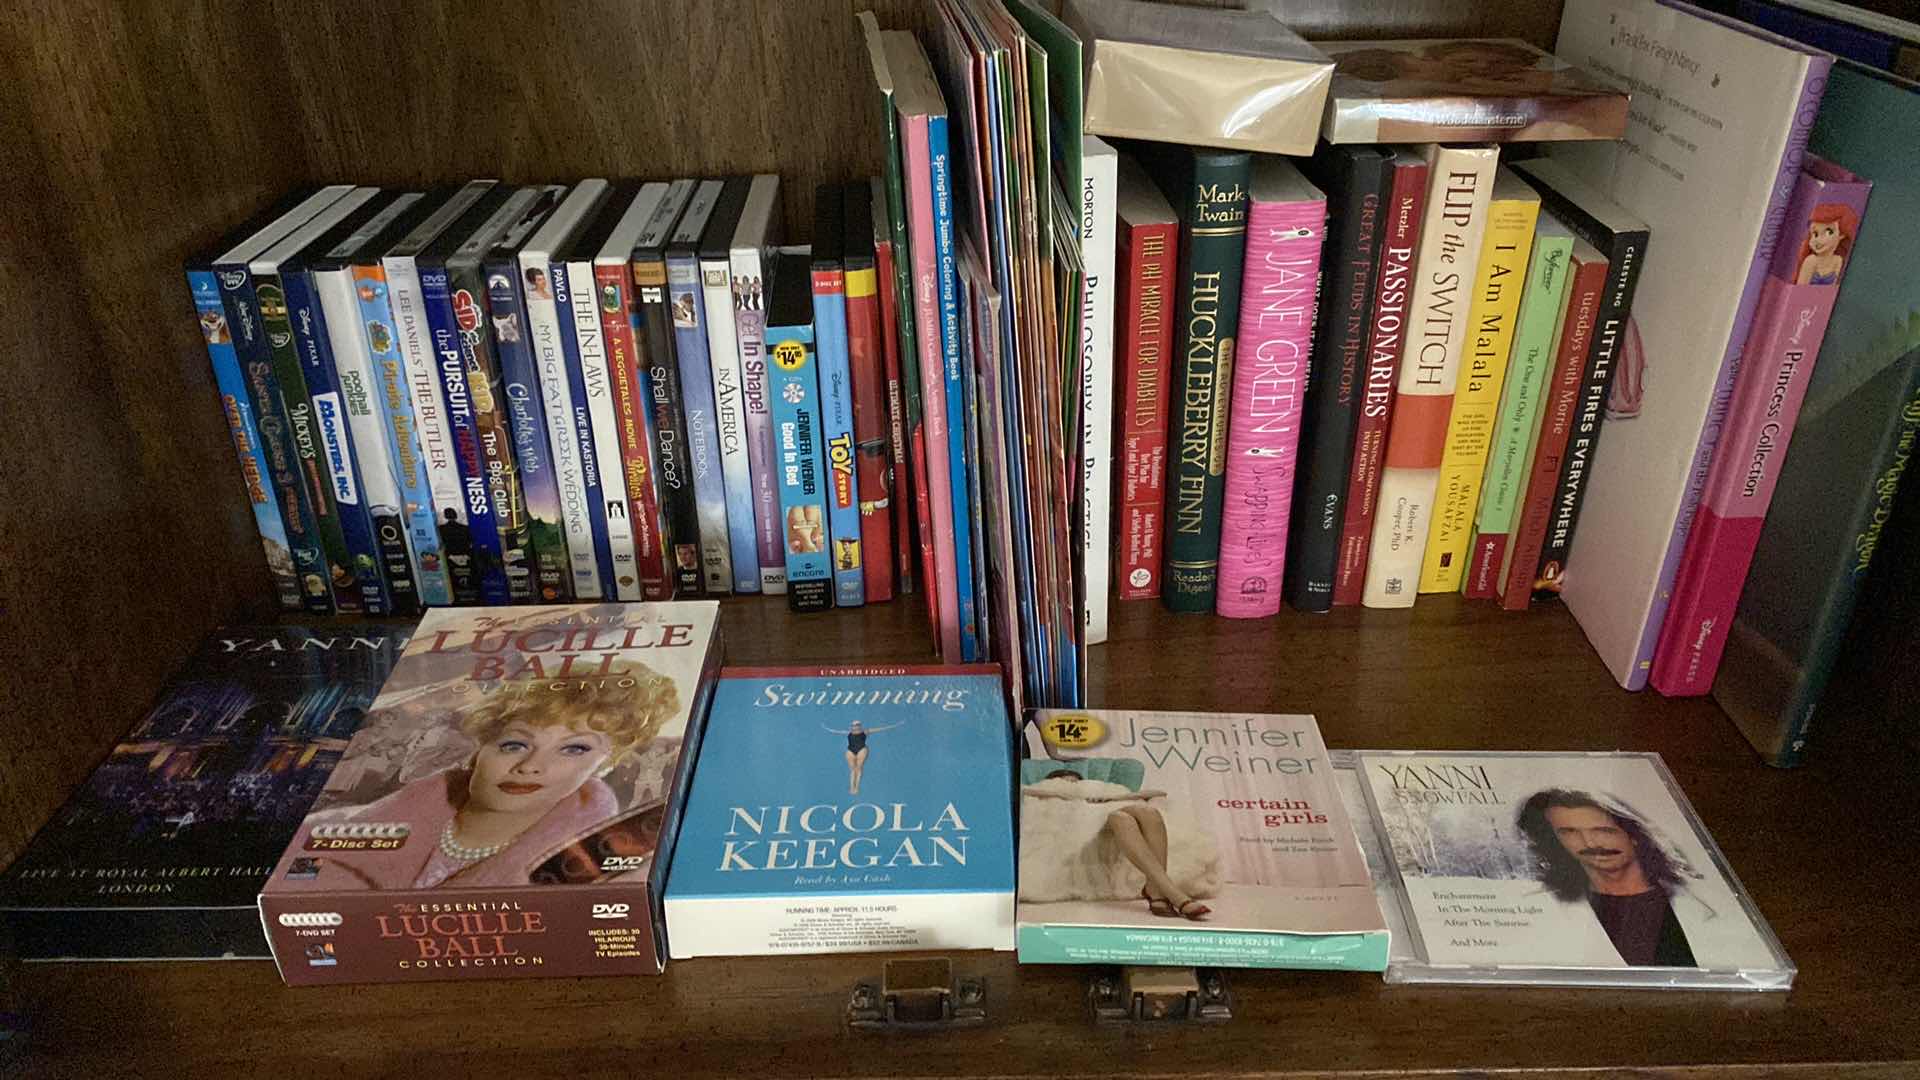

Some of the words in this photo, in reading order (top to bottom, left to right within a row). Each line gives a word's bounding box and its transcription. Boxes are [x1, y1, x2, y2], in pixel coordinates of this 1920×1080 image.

[935, 154, 946, 217] Springtime
[1198, 183, 1246, 203] Mark
[1442, 171, 1479, 228] FLIP
[1083, 177, 1094, 240] MORTON
[1197, 203, 1245, 223] Twain
[1358, 193, 1380, 253] GREAT
[1398, 196, 1414, 240] Metzler
[939, 219, 950, 254] Jumbo
[1142, 233, 1165, 259] THE
[1441, 233, 1466, 265] the
[551, 267, 568, 303] PAVLO
[943, 256, 954, 300] Coloring
[1486, 263, 1512, 303] Am
[1618, 246, 1635, 289] CELESTE
[398, 289, 412, 310] LEE
[1259, 252, 1313, 329] JANE
[1351, 260, 1371, 312] FEUDS
[1613, 292, 1625, 307] NG
[453, 288, 480, 333] SID
[573, 288, 595, 325] THE
[945, 302, 956, 312] &
[1139, 285, 1162, 337] MIRACLE
[1348, 312, 1362, 332] IN
[1571, 290, 1596, 353] tuesdays
[435, 329, 450, 351] the
[538, 324, 552, 342] MY
[946, 312, 958, 356] Activity
[1364, 246, 1412, 418] PASSIONARIES
[1416, 271, 1460, 385] SWITCH
[541, 346, 557, 379] BIG
[577, 327, 605, 398] IN-LAWS
[743, 341, 763, 357] In
[1137, 343, 1160, 366] FOR
[1469, 313, 1503, 393] Malala
[1593, 319, 1620, 380] LITTLE
[440, 350, 471, 418] PURSUIT
[650, 366, 670, 403] Shall
[718, 368, 731, 381] IN
[949, 356, 959, 381] Book
[1181, 271, 1220, 470] HUCKLEBERRY
[1250, 339, 1300, 433] GREEN
[1337, 334, 1360, 406] HISTORY
[1562, 357, 1581, 386] with
[1767, 351, 1804, 418] Princess
[347, 370, 372, 417] poolhall
[414, 372, 433, 402] THE
[548, 380, 564, 411] FAT
[744, 360, 768, 415] Shape!
[1135, 368, 1159, 428] DIABETES
[452, 414, 470, 433] of
[575, 406, 589, 427] LIVE
[718, 382, 740, 457] AMERICA
[1553, 390, 1577, 435] Morrie
[1580, 385, 1604, 433] FIRES
[420, 402, 447, 470] BUTLER
[579, 428, 591, 440] IN
[623, 416, 638, 450] MOVIE
[690, 409, 710, 480] NOTEBOOK
[796, 408, 813, 456] JENNIFER
[520, 445, 541, 474] Web
[580, 440, 597, 488] KASTORIA
[658, 429, 681, 489] Dance?
[827, 431, 853, 477] TOY
[1743, 423, 1780, 497] Collection
[482, 430, 498, 457] The
[494, 488, 511, 519] Club
[800, 458, 817, 496] WEINER
[834, 472, 850, 506] STORY
[562, 469, 584, 535] WEDDING
[1177, 475, 1206, 535] FINN
[1323, 493, 1339, 530] EVANS
[1440, 473, 1462, 543] YOUSAFZAI
[1452, 483, 1473, 533] MALALA
[1552, 438, 1590, 549] EVERYWHERE
[1854, 507, 1890, 573] Dragon
[220, 638, 411, 652] YANNI
[428, 622, 695, 655] LUCILLE
[463, 651, 633, 683] BALL
[819, 668, 907, 677] UNABRIDGED
[423, 678, 665, 694] COLLECTION
[753, 680, 969, 711] Swimming
[1120, 717, 1306, 748] Jennifer
[1143, 744, 1319, 776] Weiner
[1380, 764, 1493, 790] YANNI
[725, 802, 971, 836] NICOLA
[1216, 797, 1313, 811] certain
[1263, 811, 1329, 828] girls
[310, 838, 369, 850] 7-Disc
[370, 837, 403, 849] Set
[601, 855, 645, 867] DVD
[716, 836, 971, 873] KEEGAN
[19, 867, 58, 879] LIVE
[95, 867, 150, 879] ROYAL
[158, 866, 222, 878] ALBERT
[229, 865, 275, 877] HALL
[97, 883, 176, 894] LONDON
[376, 911, 548, 938] LUCILLE
[420, 901, 524, 913] ESSENTIAL
[592, 903, 631, 914] DVD
[321, 928, 336, 937] SET
[415, 936, 520, 959] BALL
[1449, 938, 1472, 948] And
[398, 955, 545, 971] COLLECTION
